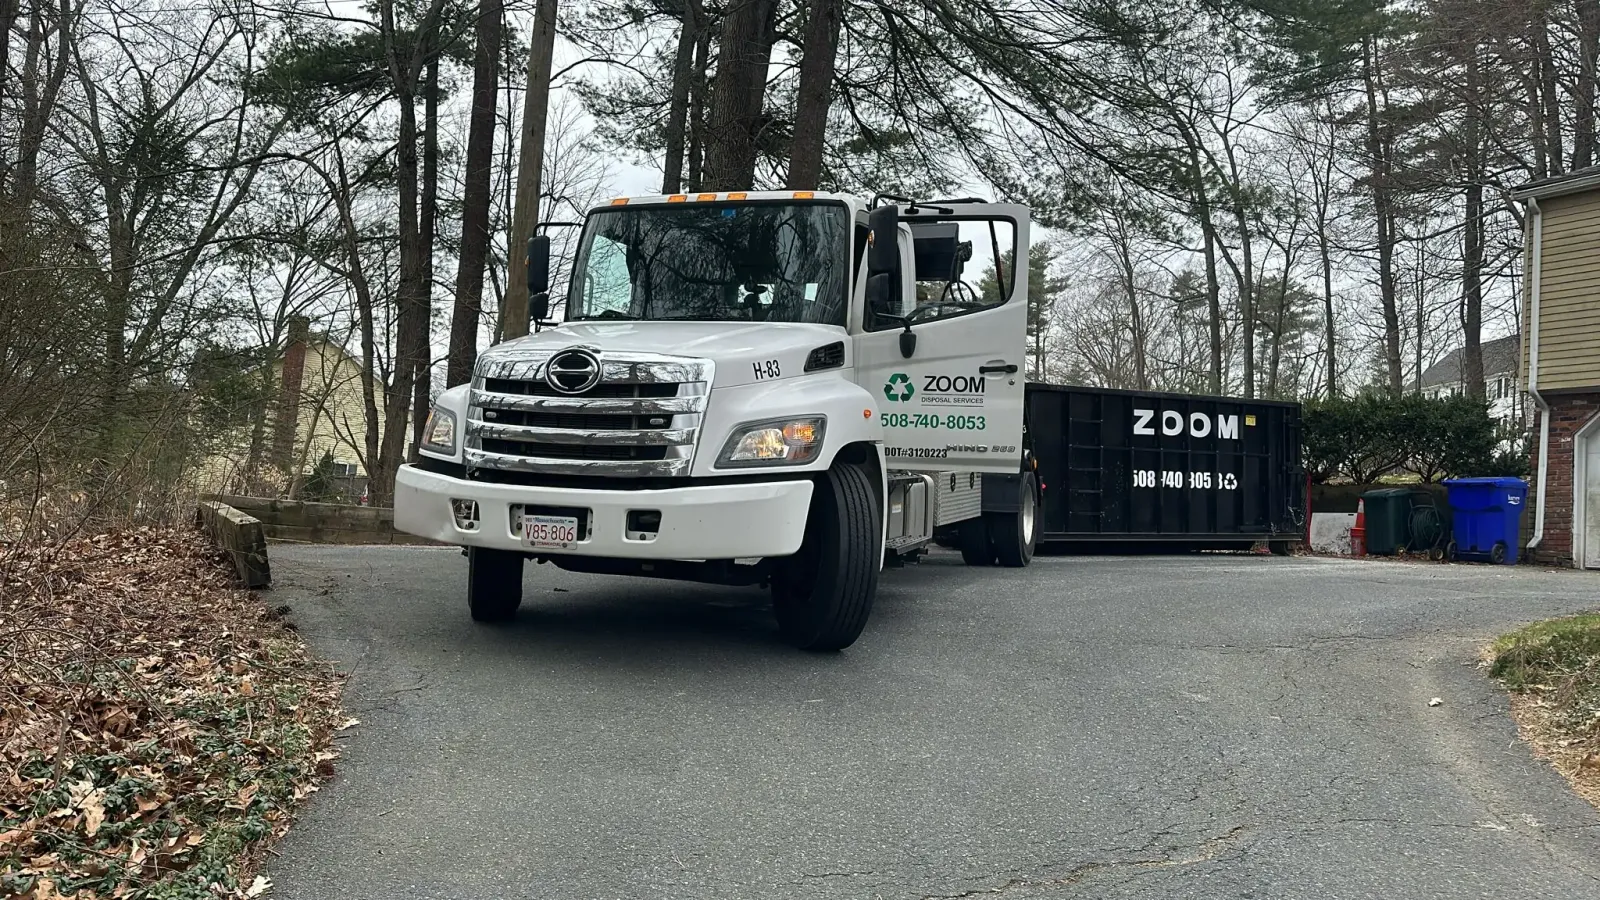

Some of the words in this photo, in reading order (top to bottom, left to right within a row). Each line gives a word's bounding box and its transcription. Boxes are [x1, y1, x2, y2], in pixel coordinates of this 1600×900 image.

[753, 359, 781, 380] H-83
[923, 375, 985, 393] ZOOM
[921, 396, 951, 404] DISPOSAL
[881, 413, 986, 431] 508-740-8053
[1133, 409, 1239, 440] ZOOM
[885, 446, 947, 459] DOT#3120223
[946, 443, 988, 453] HINO
